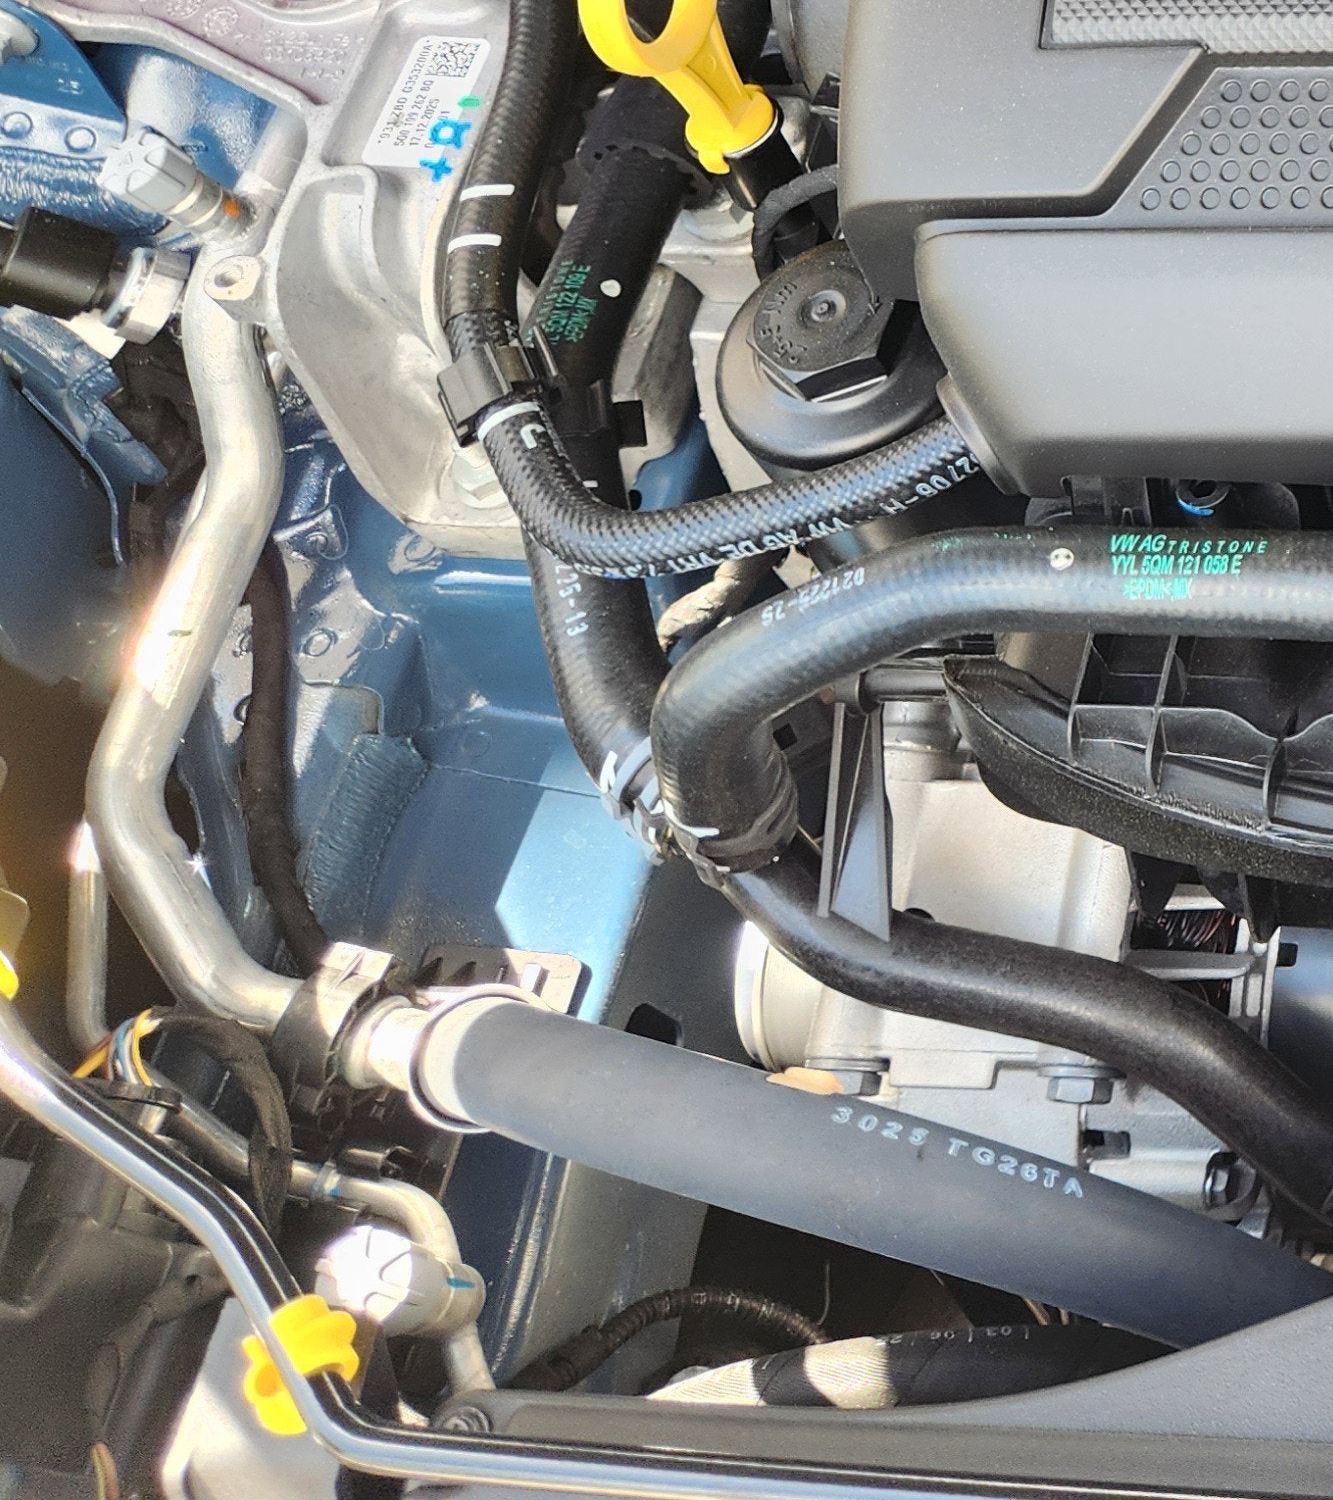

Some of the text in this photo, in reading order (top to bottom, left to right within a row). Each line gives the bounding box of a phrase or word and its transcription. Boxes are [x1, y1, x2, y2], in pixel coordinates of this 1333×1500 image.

[409, 98, 441, 147] 17.12.2025
[807, 516, 852, 541] VW
[1110, 534, 1269, 554] VW AG TRISTONE
[1177, 555, 1201, 575] 121
[1230, 554, 1244, 576] E
